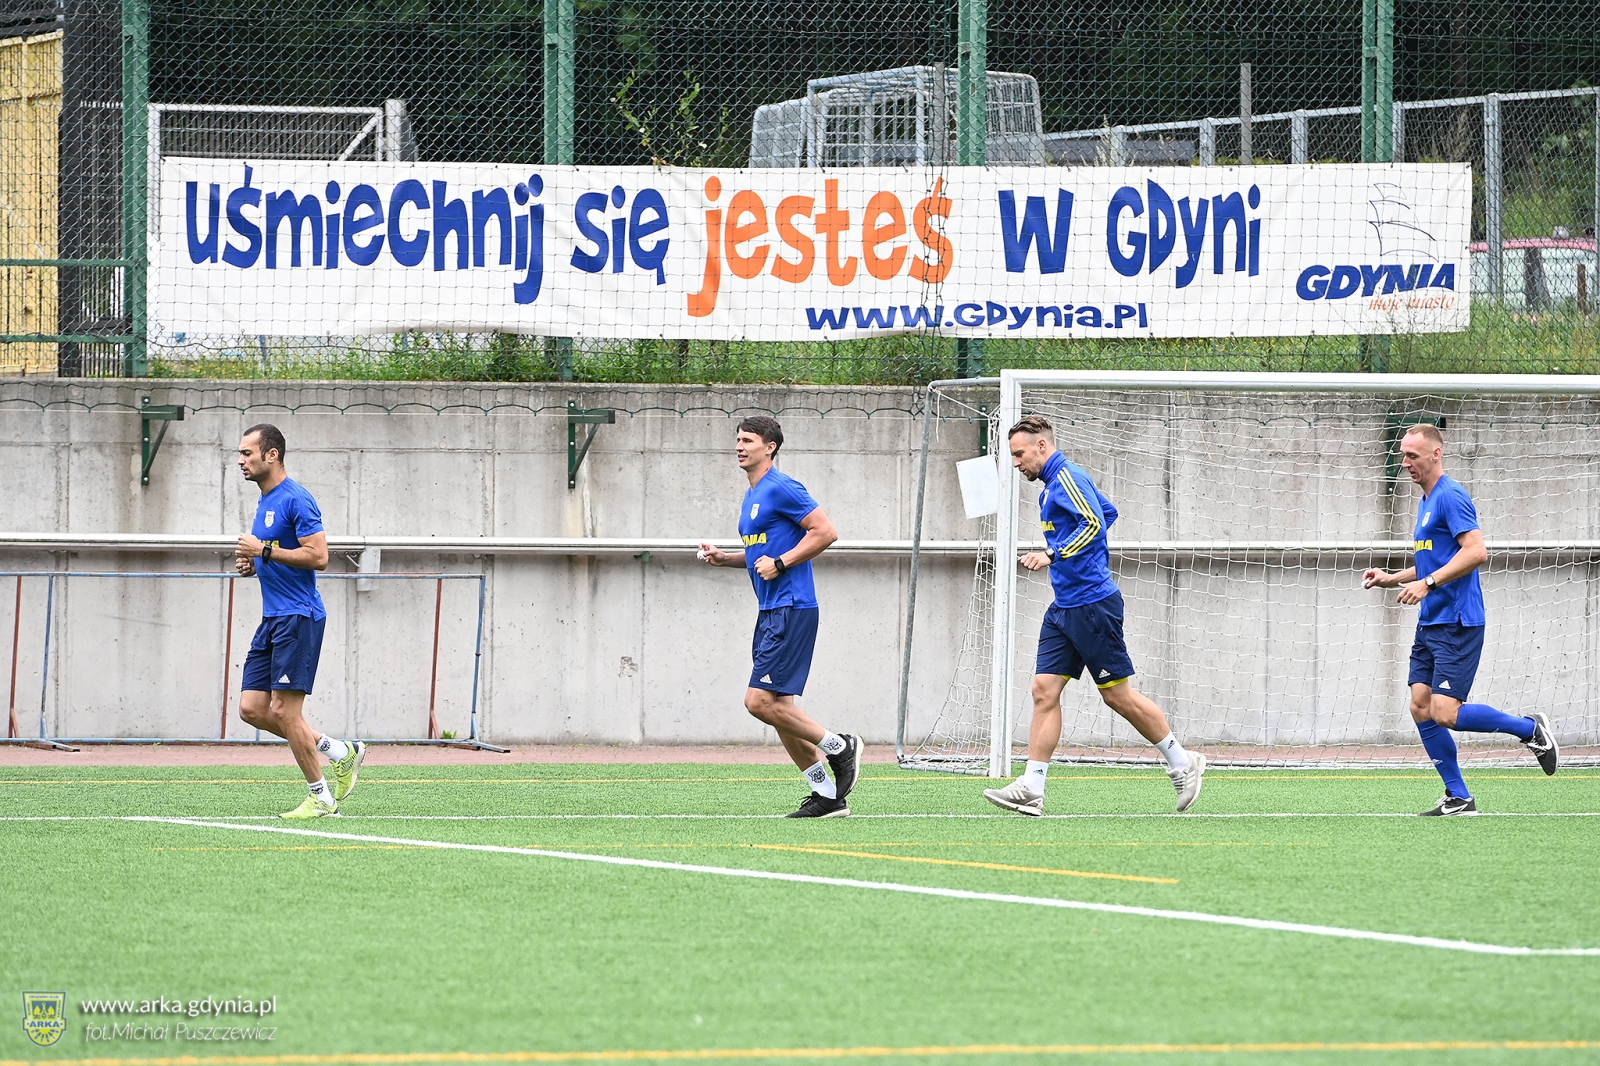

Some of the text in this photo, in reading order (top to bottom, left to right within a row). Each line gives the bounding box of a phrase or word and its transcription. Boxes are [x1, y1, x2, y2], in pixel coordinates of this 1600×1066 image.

[570, 184, 670, 286] się
[686, 175, 954, 318] jesteś
[1296, 263, 1455, 301] GDYNIA
